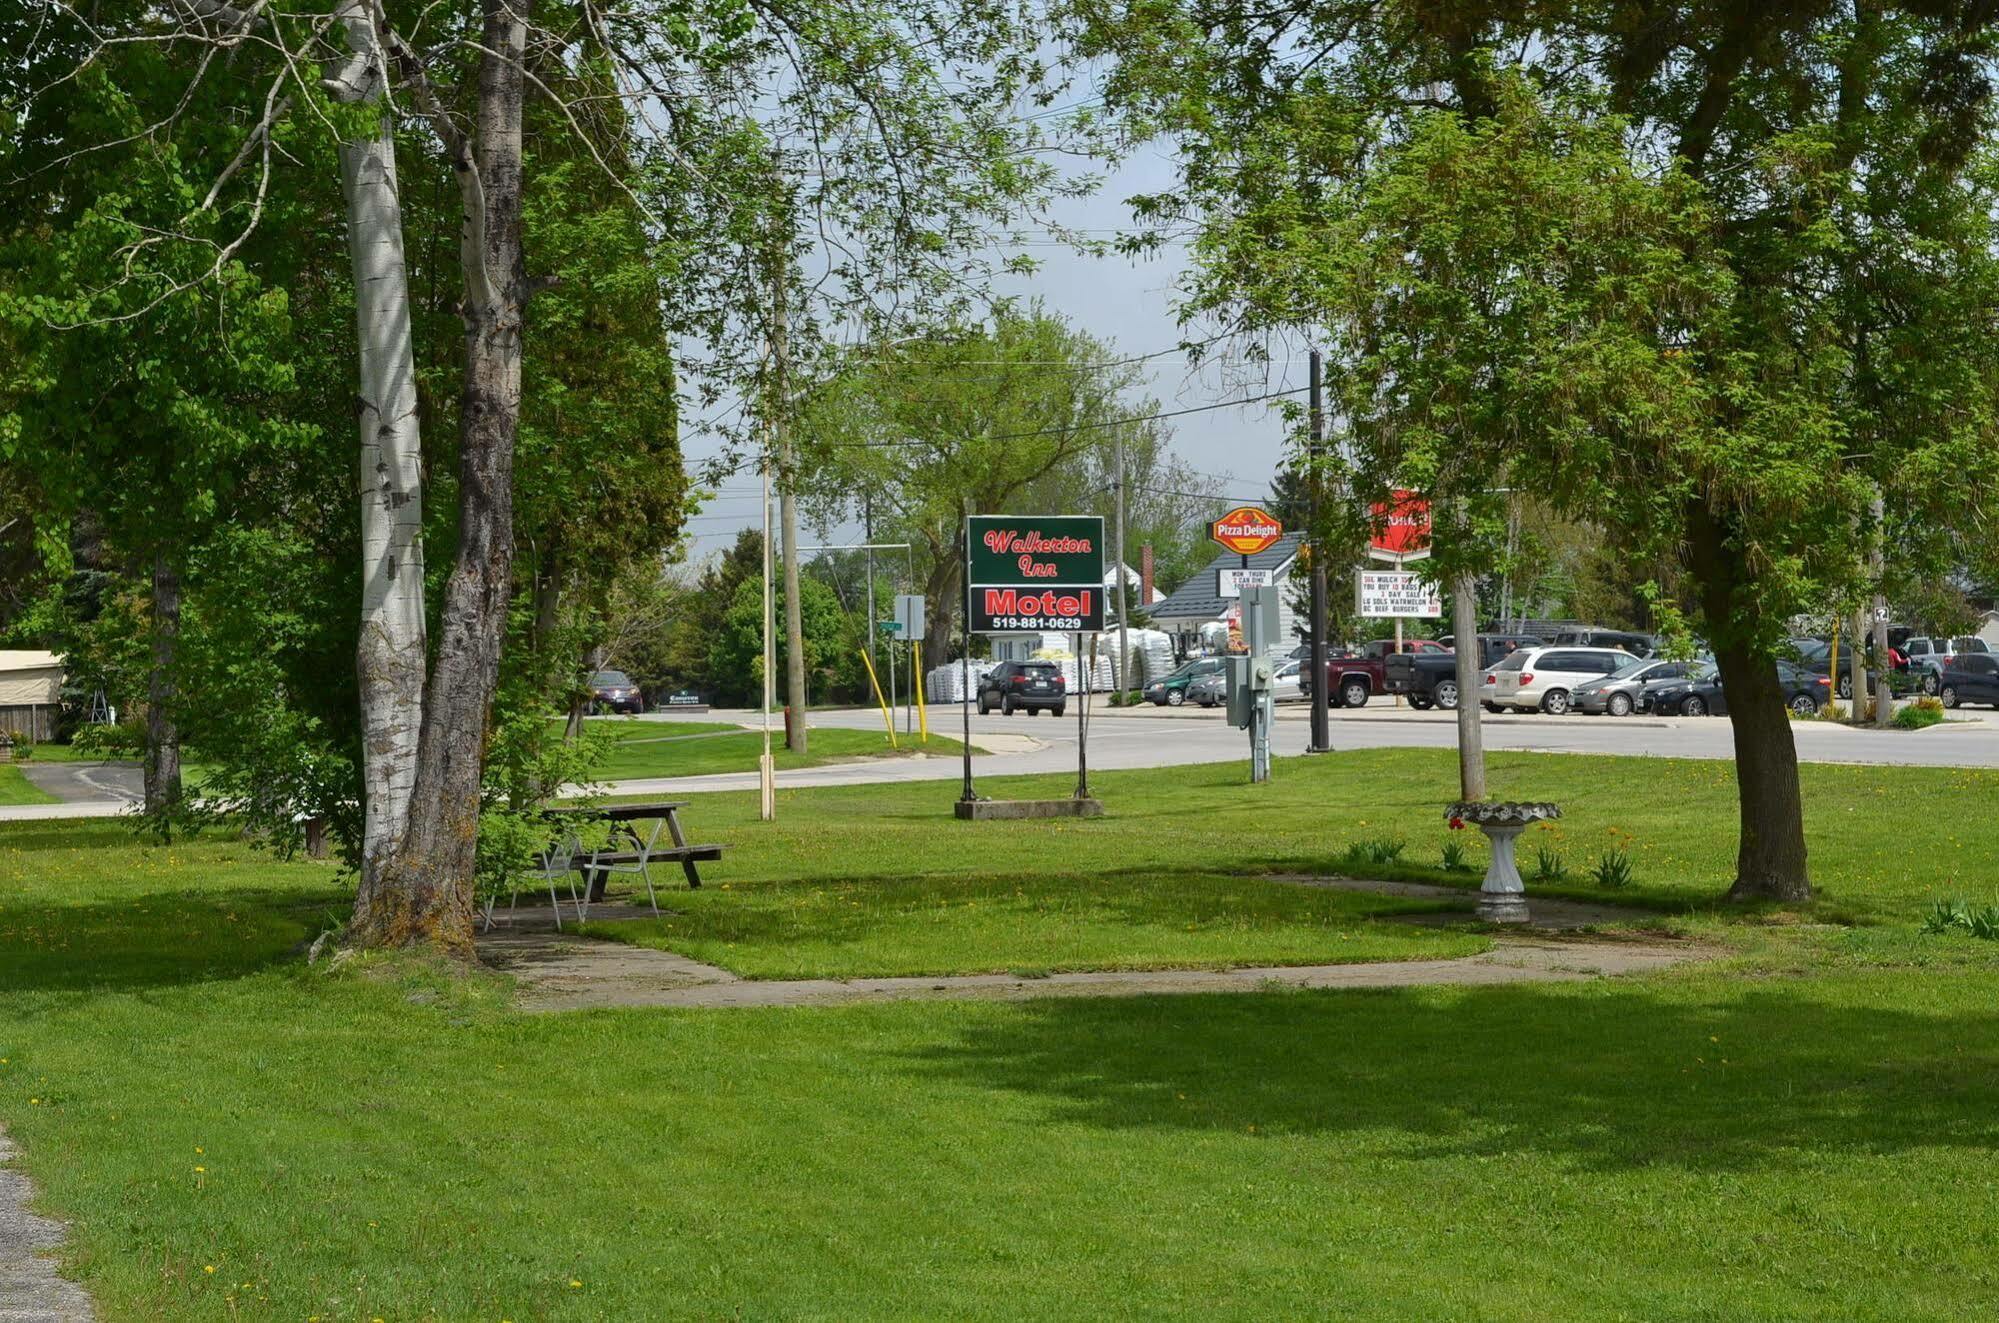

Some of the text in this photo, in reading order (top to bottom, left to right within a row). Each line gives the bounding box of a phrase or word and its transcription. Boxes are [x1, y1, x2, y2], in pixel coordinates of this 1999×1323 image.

[984, 530, 1092, 553] Walkerton
[1218, 524, 1277, 538] Pizza Delight
[1018, 555, 1058, 577] Inn
[984, 589, 1091, 617] Motel
[993, 618, 1082, 629] 519-881-0629
